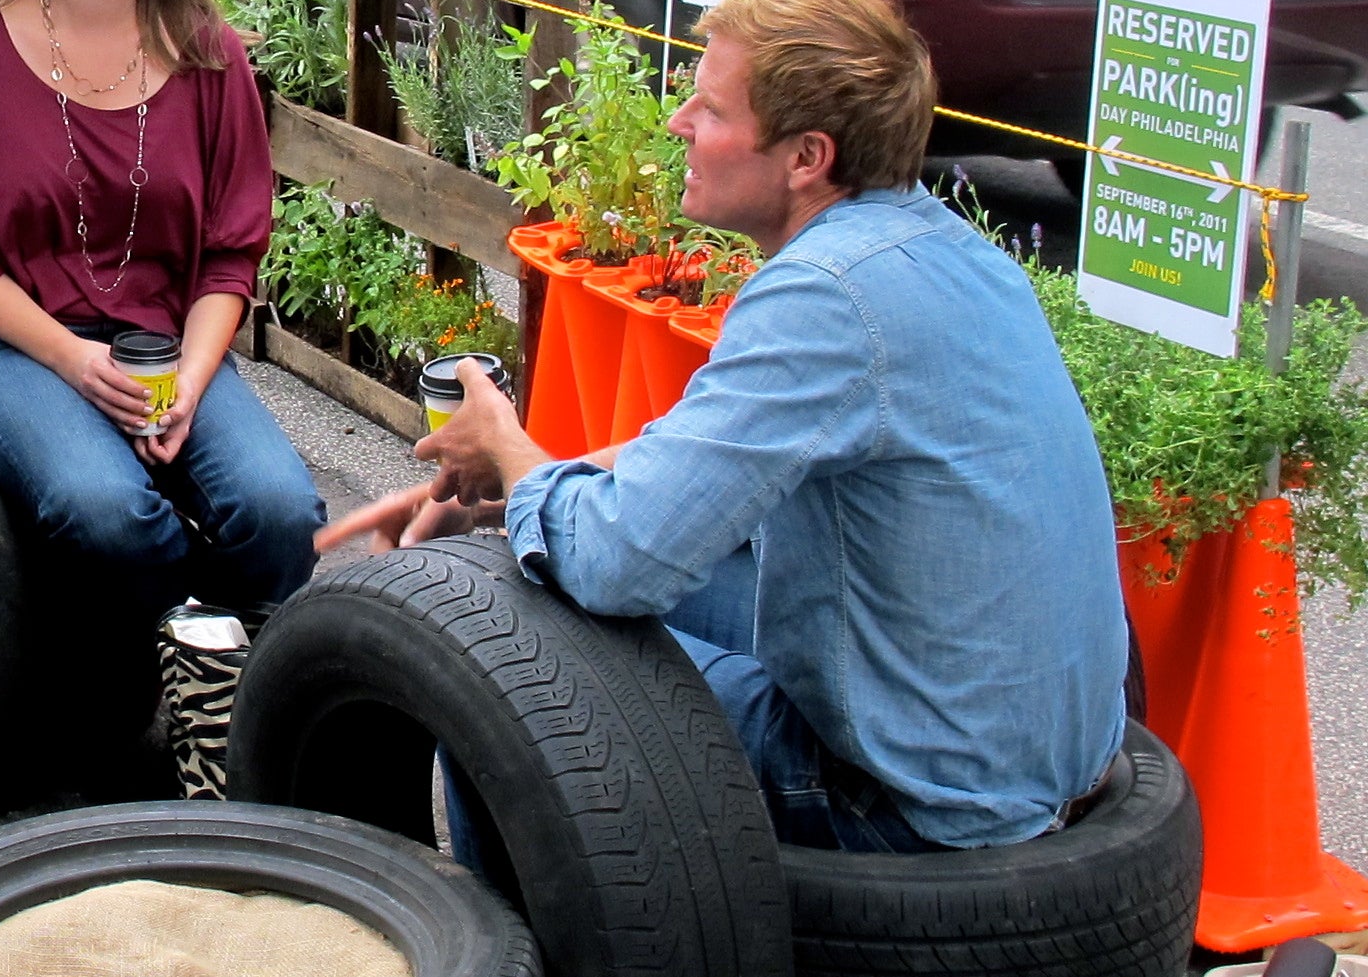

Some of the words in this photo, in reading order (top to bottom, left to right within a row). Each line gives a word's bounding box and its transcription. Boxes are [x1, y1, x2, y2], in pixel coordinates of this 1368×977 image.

[1107, 4, 1250, 63] RESERVED
[1102, 59, 1244, 127] PARK(ing)
[1100, 103, 1128, 125] DAY
[1130, 110, 1240, 153] PHILADELPHIA
[1096, 183, 1168, 217] SEPTEMBER
[1198, 212, 1227, 233] 2011
[1093, 205, 1146, 248] 8AM
[1152, 235, 1163, 245] -
[1169, 226, 1226, 271] 5PM
[1129, 258, 1158, 280] JOIN
[1160, 266, 1182, 286] US!
